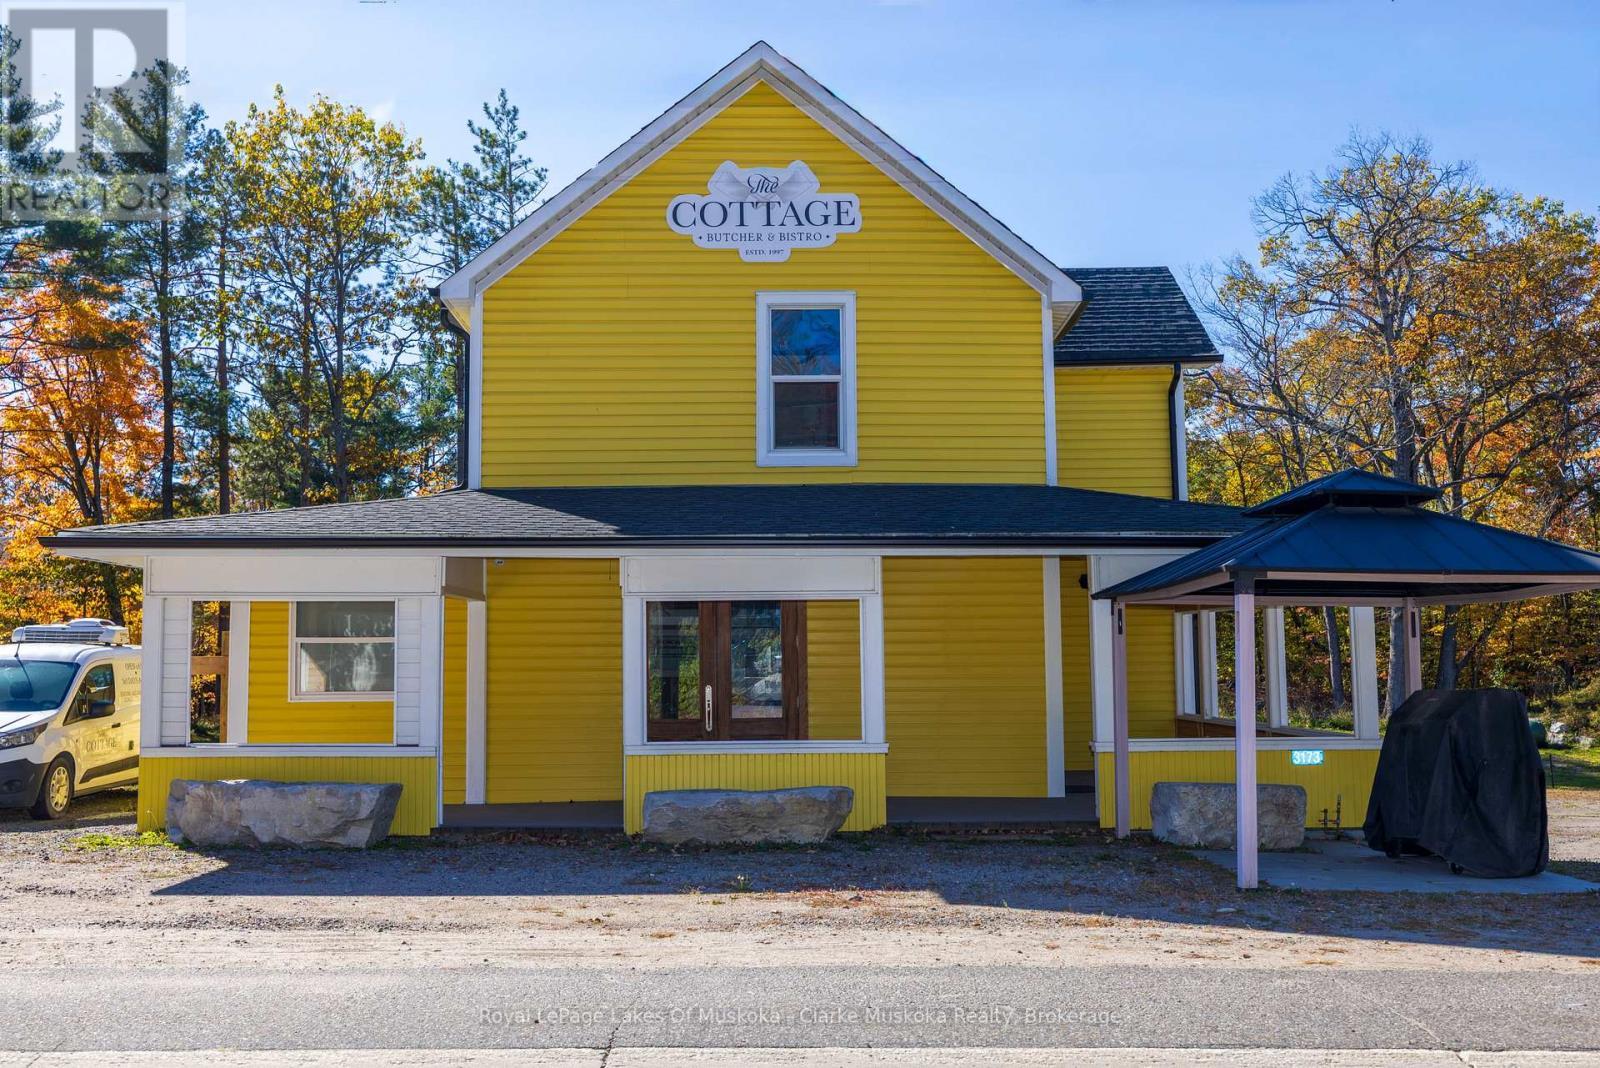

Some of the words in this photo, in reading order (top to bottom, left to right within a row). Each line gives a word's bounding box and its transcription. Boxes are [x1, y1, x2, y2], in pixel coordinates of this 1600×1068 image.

[747, 173, 780, 194] The
[672, 200, 856, 228] COTTAGE
[706, 232, 763, 242] BUTCHER
[767, 231, 776, 241] &
[779, 231, 823, 242] BISTRO
[1292, 750, 1321, 764] 3173
